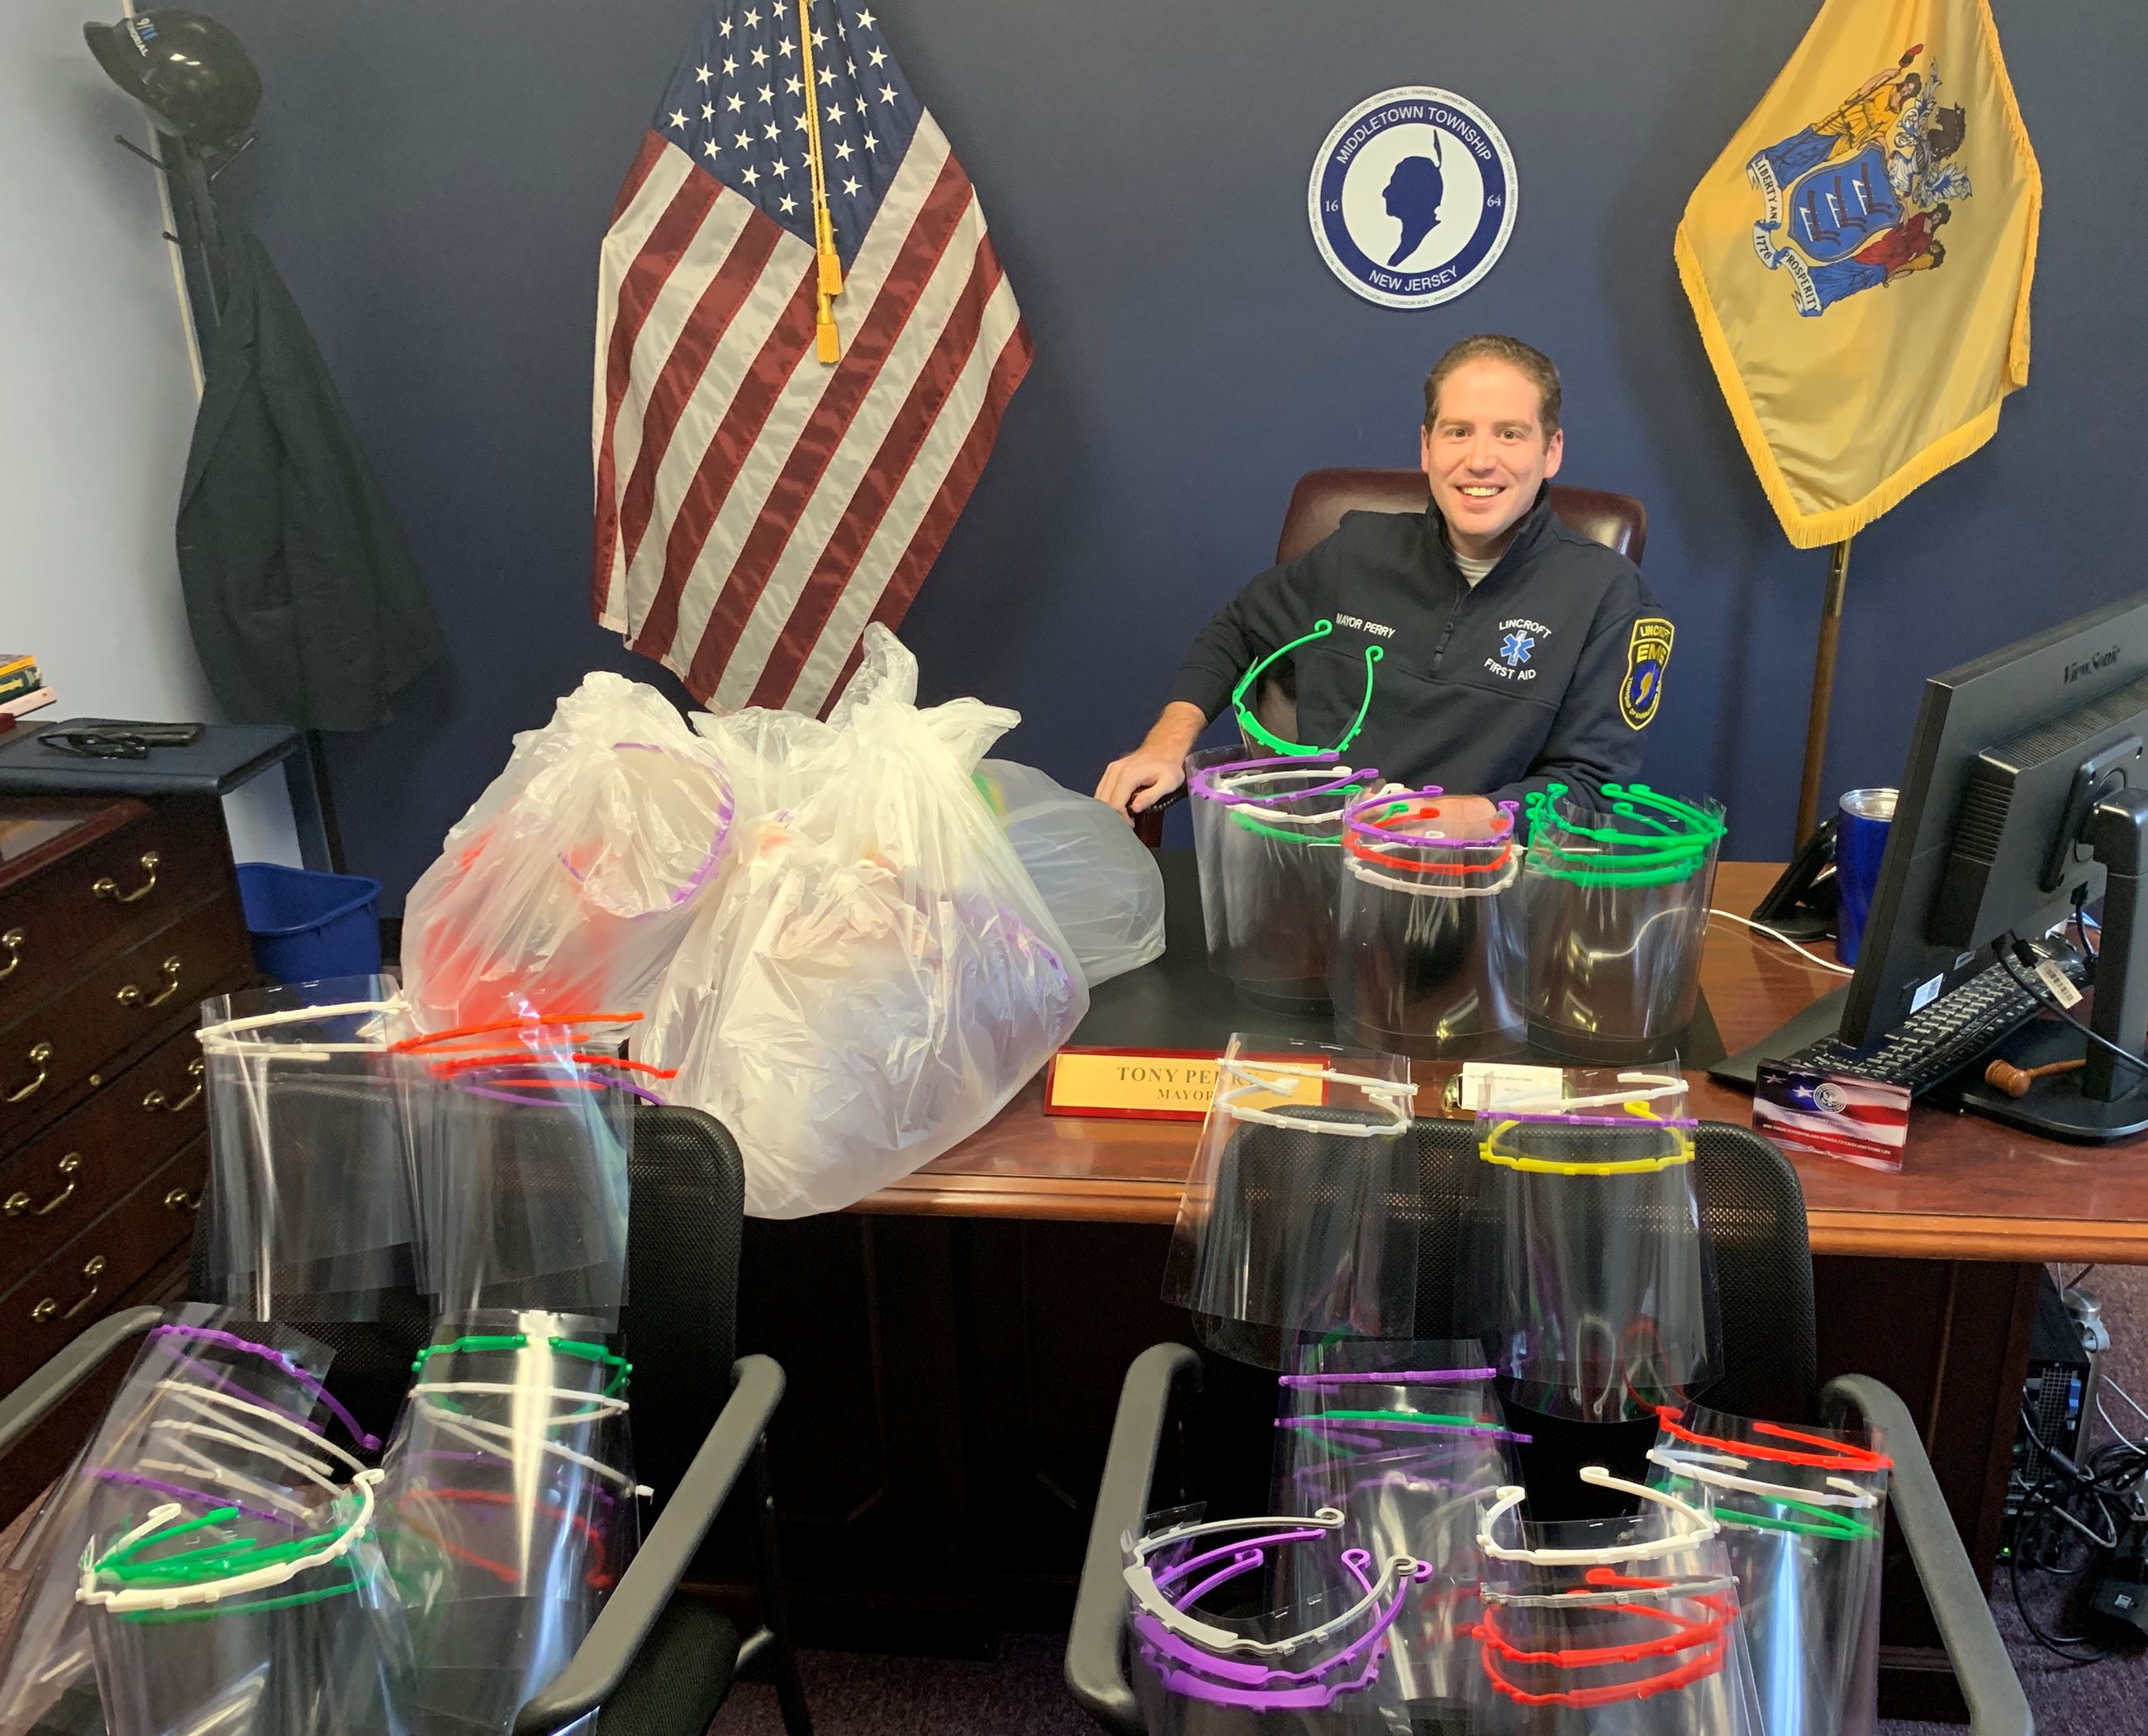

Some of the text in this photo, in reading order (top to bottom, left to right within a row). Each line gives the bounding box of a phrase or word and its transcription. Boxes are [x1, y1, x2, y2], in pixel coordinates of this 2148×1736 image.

[1336, 105, 1493, 165] MIDDLETOWN TOWNSHIP
[1486, 194, 1502, 207] 64
[1754, 157, 1780, 226] LIBERTY AND
[1324, 200, 1339, 212] 16
[1756, 235, 1773, 260] 1776
[1368, 265, 1458, 292] NEW JERSEY
[1781, 250, 1819, 313] PROSPERITY
[1335, 612, 1396, 640] MAYOR PERRY
[1499, 618, 1552, 640] LINCROFT
[1637, 644, 1667, 666] EMS
[1484, 658, 1537, 681] FIRST AID
[1117, 1067, 1179, 1083] TONY
[1157, 1088, 1214, 1101] MAYOR
